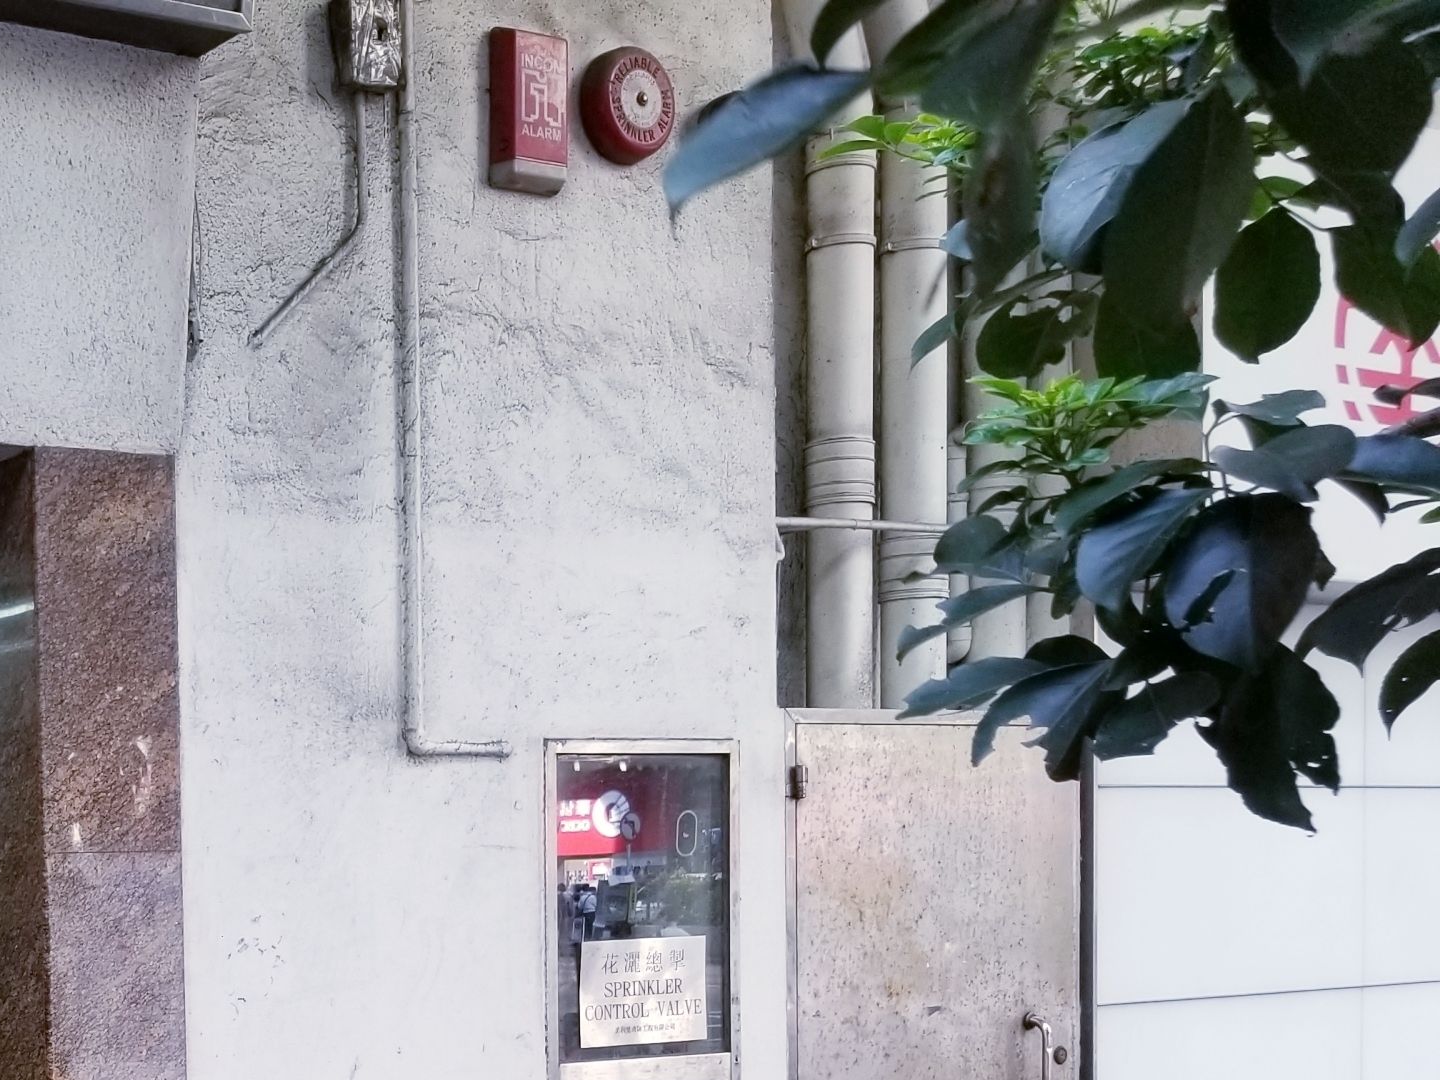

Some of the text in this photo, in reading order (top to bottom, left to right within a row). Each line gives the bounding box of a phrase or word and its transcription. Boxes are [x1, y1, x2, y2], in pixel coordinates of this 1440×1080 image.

[615, 57, 660, 84] RELIABLE
[612, 96, 656, 142] SPRINKLER
[658, 89, 672, 132] ALARM
[522, 123, 562, 141] ALARM
[603, 978, 683, 998] SPRINKLER
[584, 998, 702, 1021] CONTROL VALVE
